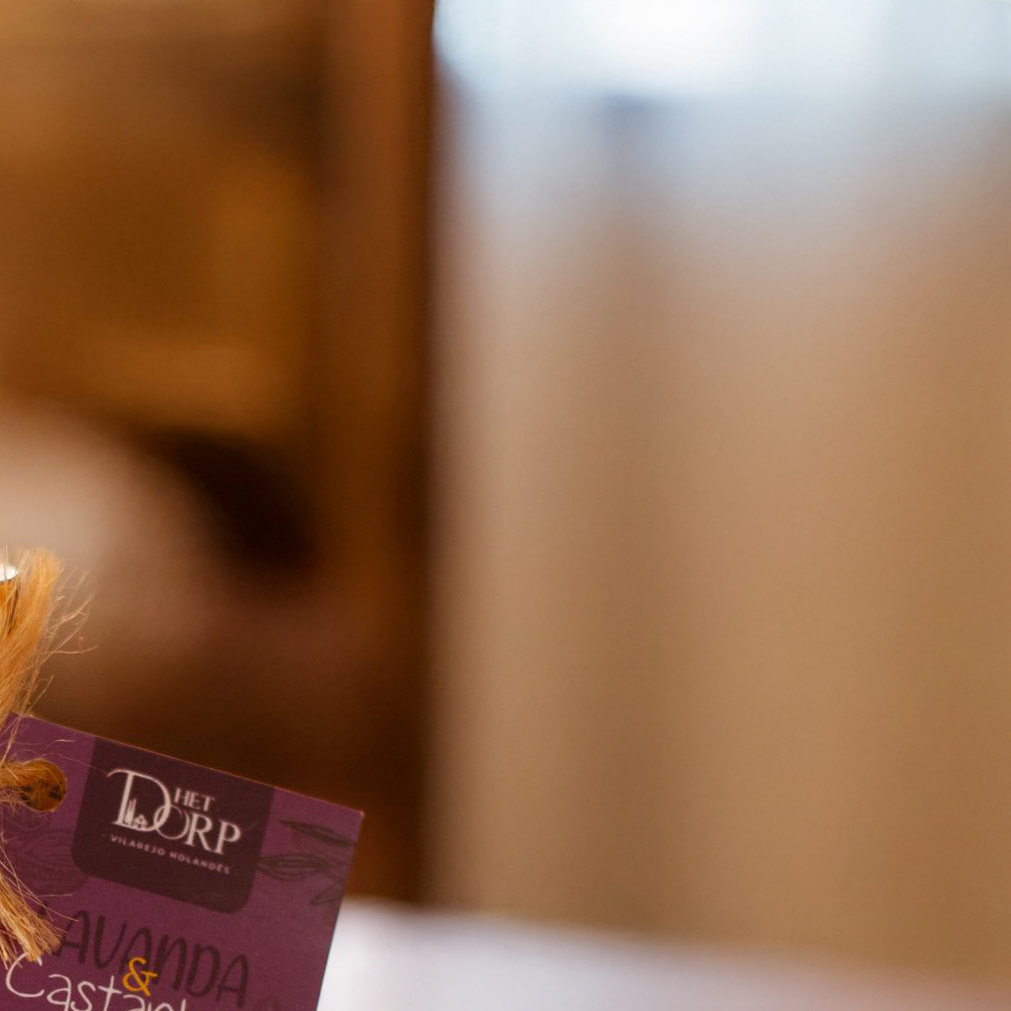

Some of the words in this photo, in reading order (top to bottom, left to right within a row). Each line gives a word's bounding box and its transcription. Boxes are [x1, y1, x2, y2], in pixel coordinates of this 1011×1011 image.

[107, 769, 241, 854] DORP
[173, 787, 215, 812] HET
[110, 834, 166, 856] VILAREJO
[169, 851, 230, 875] HOLANDÊS
[37, 900, 250, 1008] AVANDA
[122, 957, 158, 996] &
